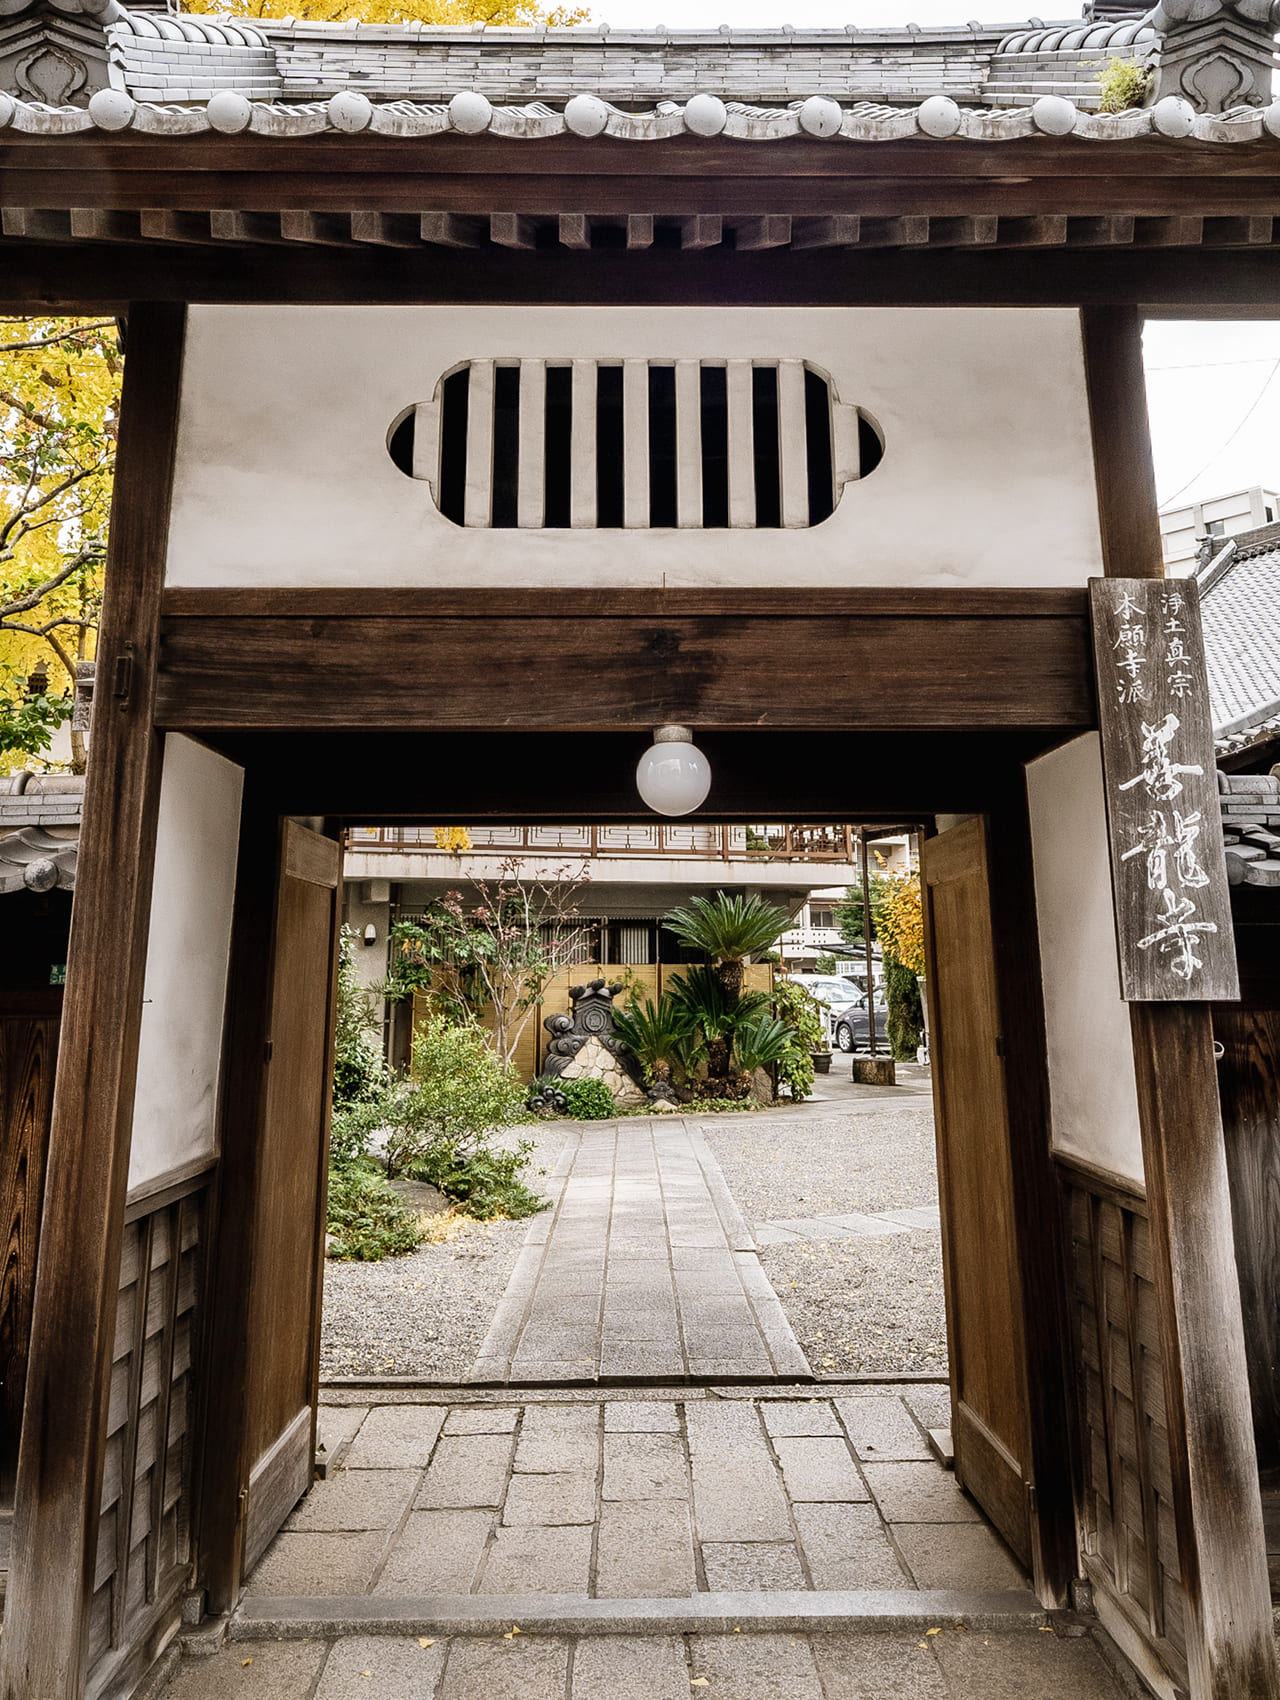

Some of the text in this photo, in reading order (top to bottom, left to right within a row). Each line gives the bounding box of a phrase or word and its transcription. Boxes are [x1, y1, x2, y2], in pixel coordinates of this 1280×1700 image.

[1113, 591, 1148, 704] 本願寺派
[1160, 592, 1194, 699] 浄土真宗
[1119, 713, 1218, 981] 善龍寺
